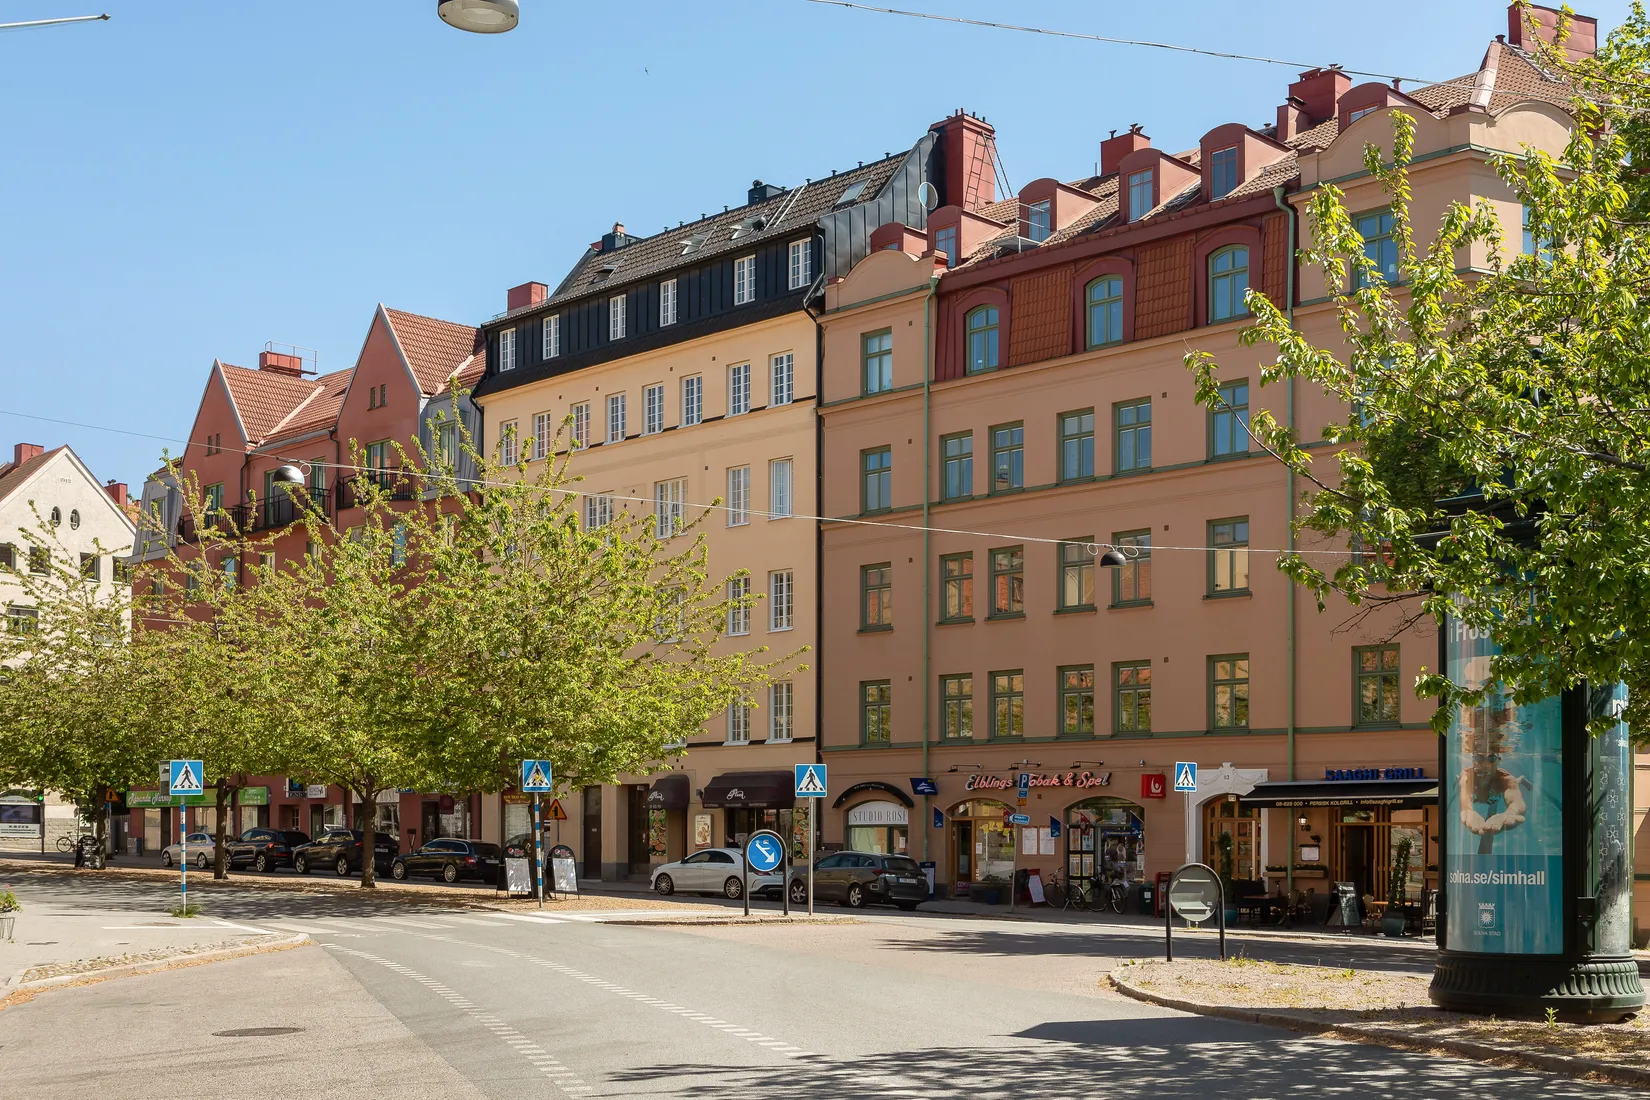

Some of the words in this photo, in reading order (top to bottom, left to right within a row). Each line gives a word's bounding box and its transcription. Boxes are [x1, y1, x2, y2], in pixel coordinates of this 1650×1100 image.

[965, 774, 1014, 791] Elblings
[1063, 771, 1075, 787] &
[1076, 771, 1111, 789] Spel
[1021, 774, 1028, 788] P
[1325, 768, 1379, 781] SAAGHI
[1383, 767, 1425, 780] GRILL
[853, 810, 883, 822] STUDIO
[1449, 869, 1545, 885] solna.se/simhall
